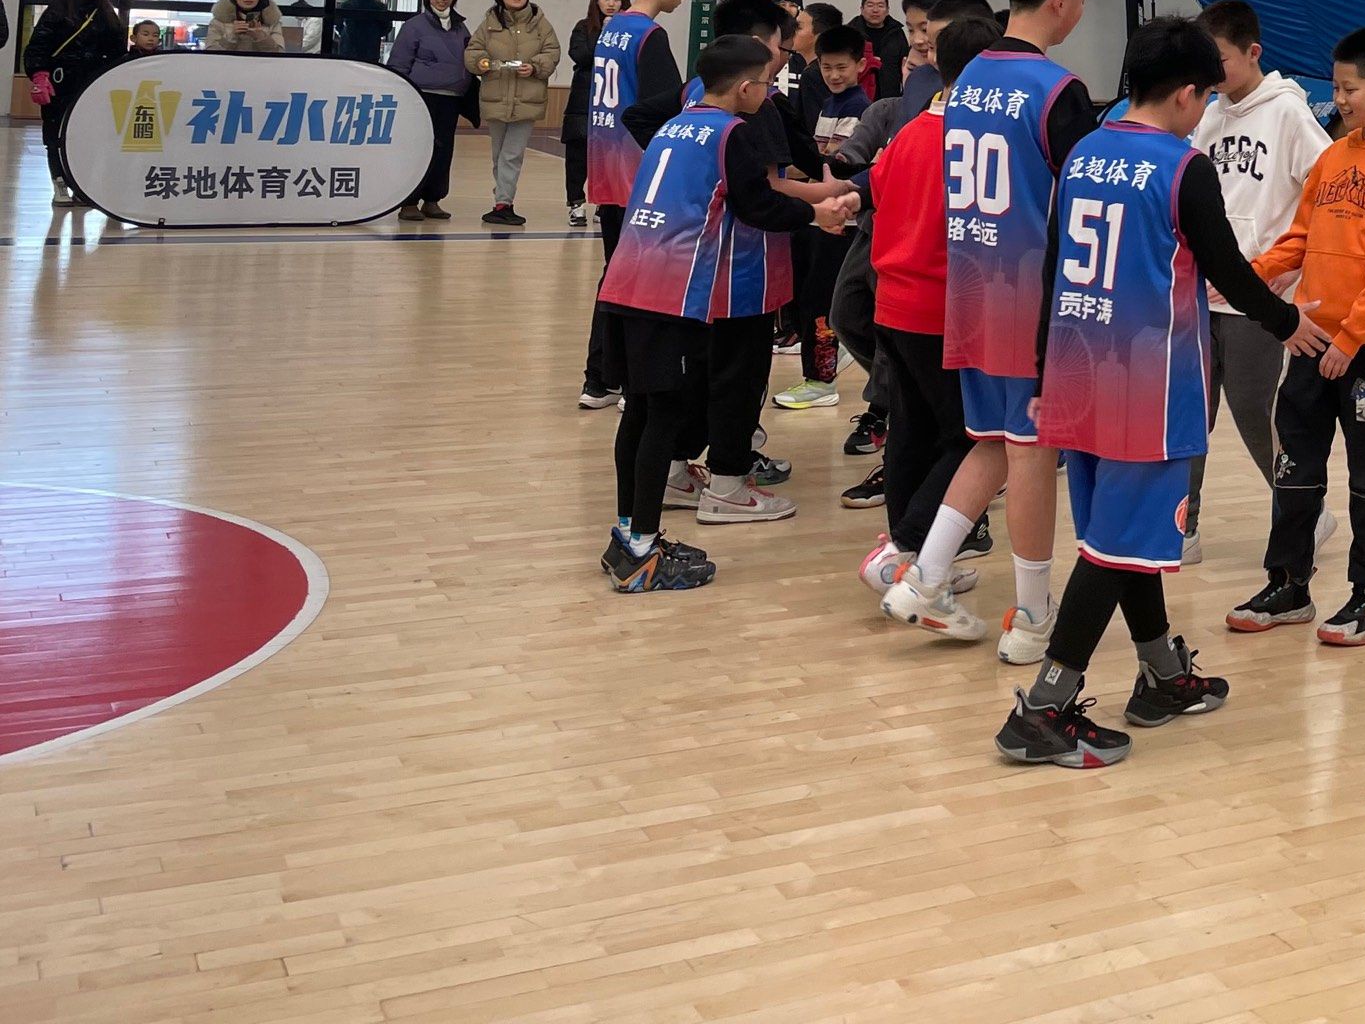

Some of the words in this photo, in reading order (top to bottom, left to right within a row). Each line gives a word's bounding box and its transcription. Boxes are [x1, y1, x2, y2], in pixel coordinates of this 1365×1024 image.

[593, 56, 619, 108] 50
[133, 105, 155, 139] 东鹏
[187, 90, 399, 146] 补水啦
[144, 165, 360, 200] 绿地体育公园
[644, 147, 672, 205] 1
[945, 128, 1010, 215] 30
[1066, 156, 1157, 191] 亚超体育
[1062, 197, 1125, 290] 51
[1058, 291, 1114, 325] 贡宇涛
